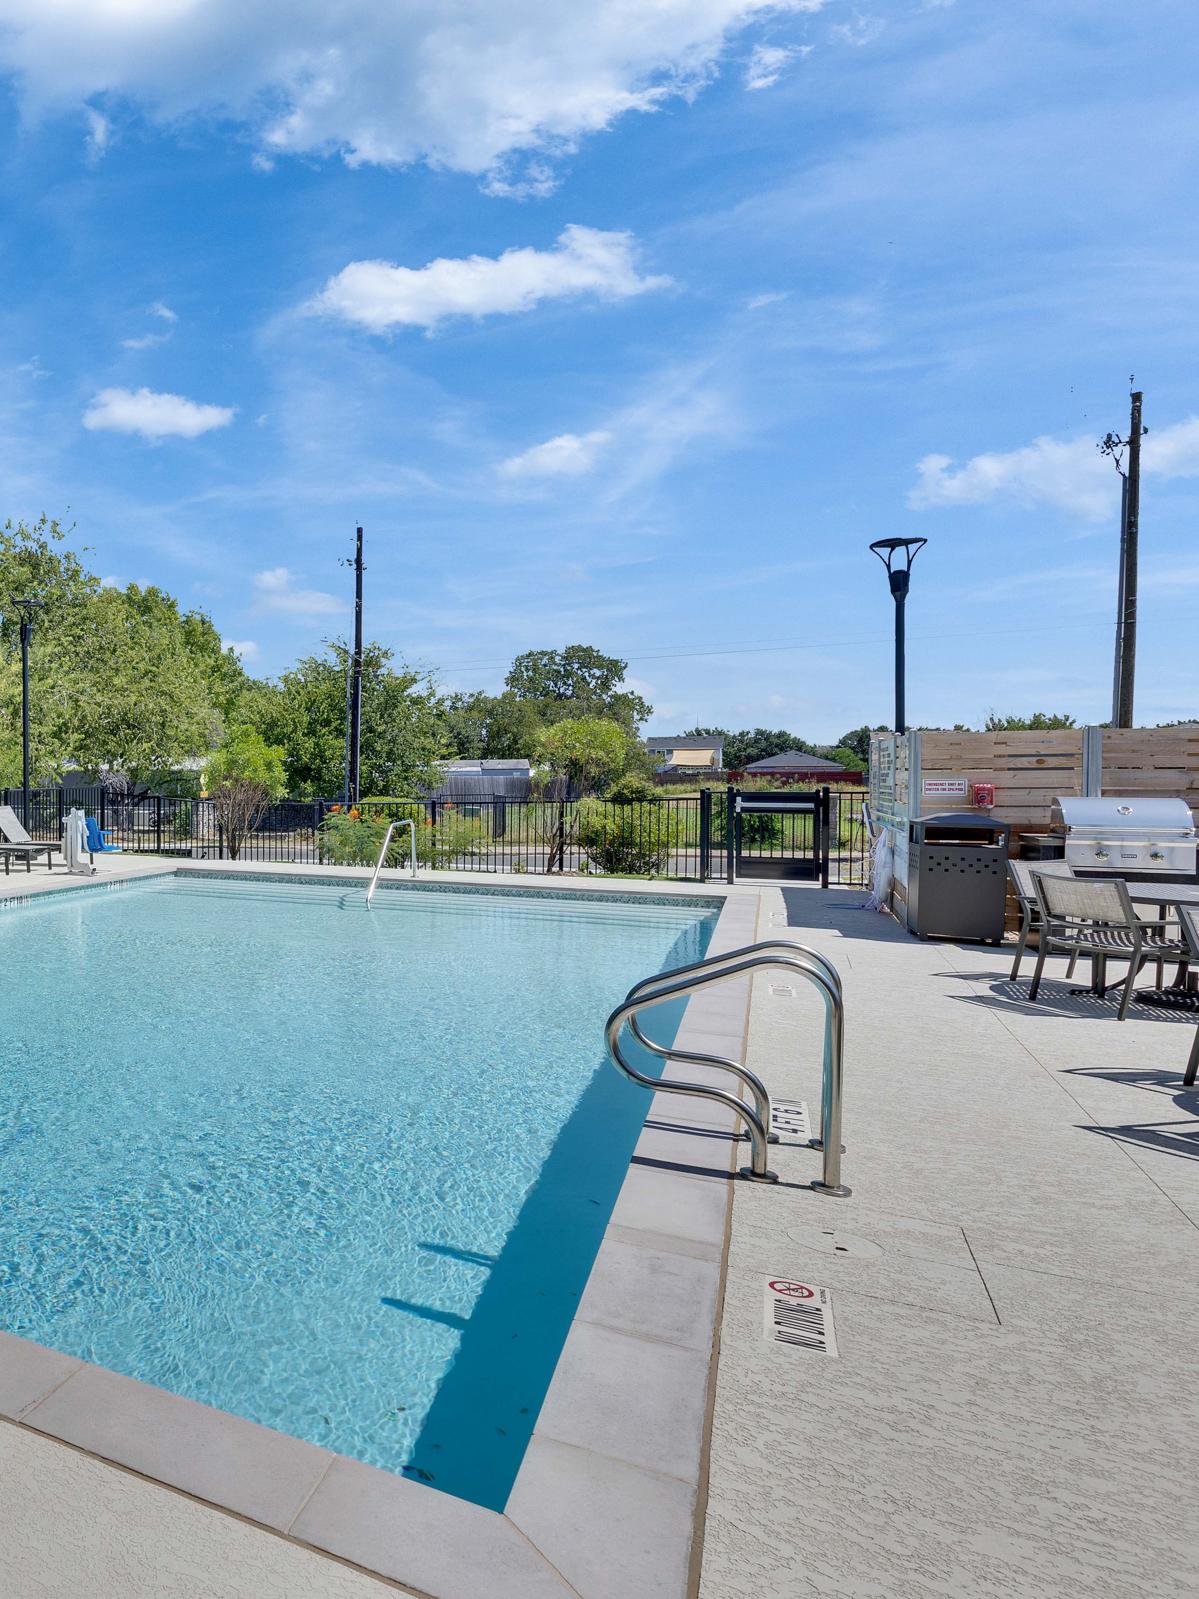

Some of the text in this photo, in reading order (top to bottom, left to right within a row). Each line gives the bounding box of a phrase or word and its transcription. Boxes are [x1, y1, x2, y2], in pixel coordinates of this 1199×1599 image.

[771, 1107, 803, 1115] 6
[772, 1114, 805, 1127] FT
[772, 1125, 805, 1134] 4
[773, 1298, 827, 1352] NO DIVING
